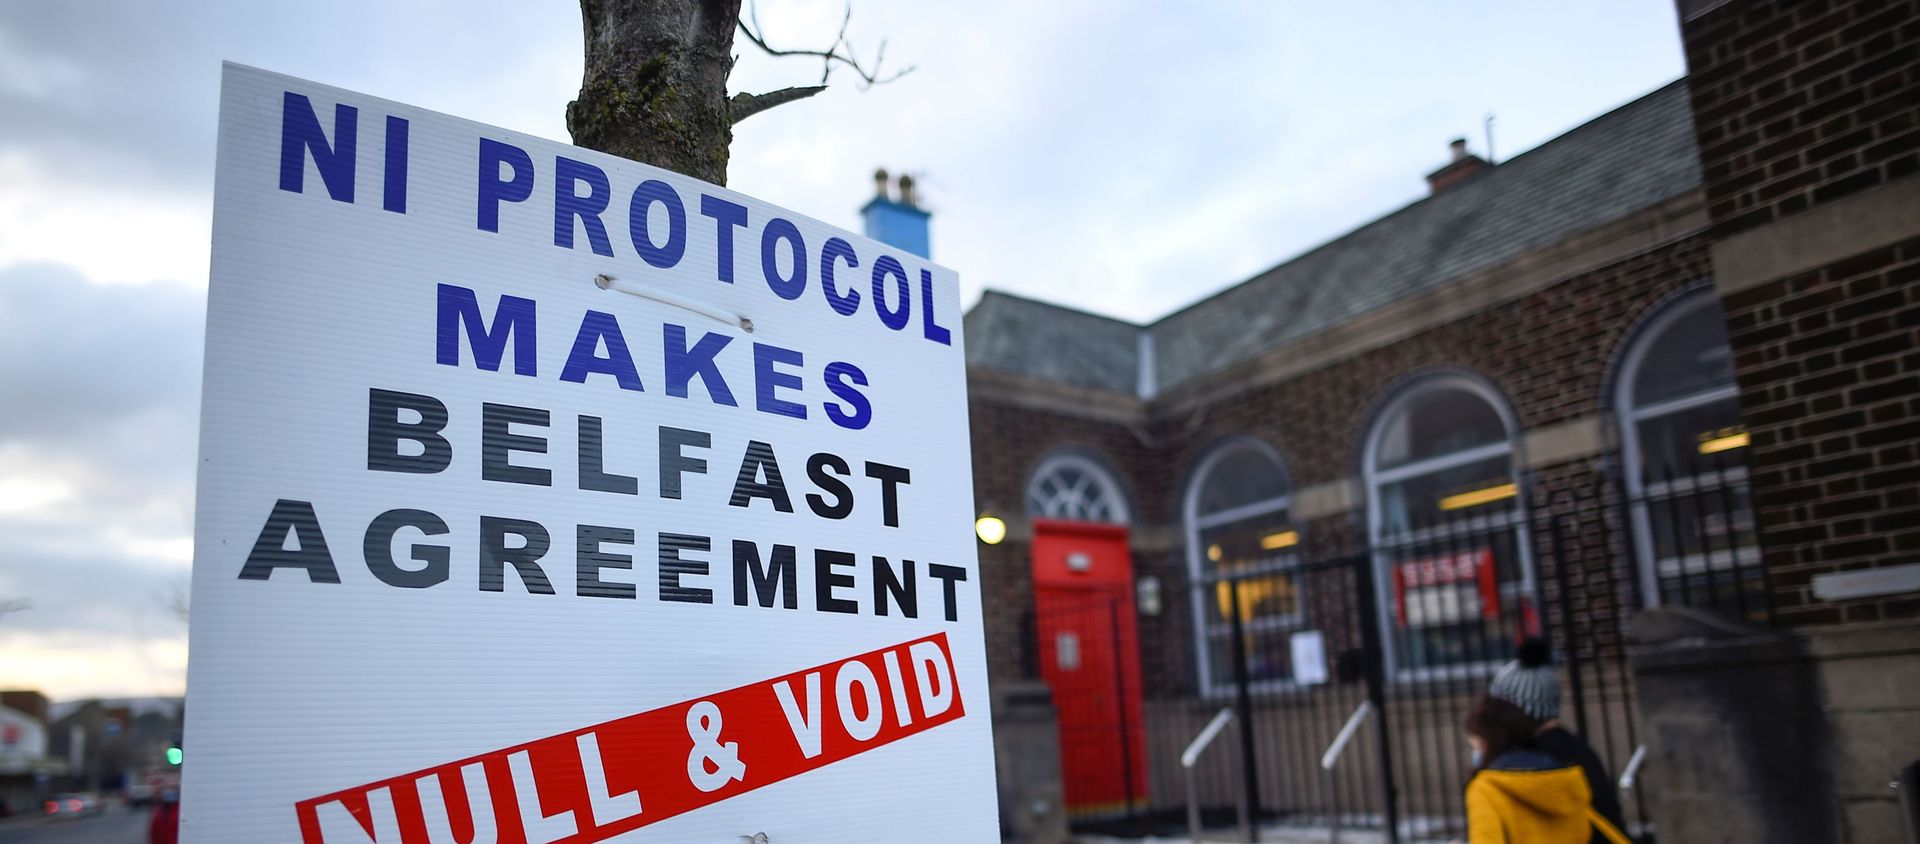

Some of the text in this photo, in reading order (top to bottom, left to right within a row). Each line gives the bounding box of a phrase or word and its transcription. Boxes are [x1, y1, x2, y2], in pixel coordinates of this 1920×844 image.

[279, 91, 952, 347] NI PROTOCOL
[437, 283, 872, 430] MAKES
[368, 388, 911, 529] BELFAST
[238, 499, 967, 622] AGREEMENT
[686, 701, 747, 792] &
[772, 640, 954, 759] VOID
